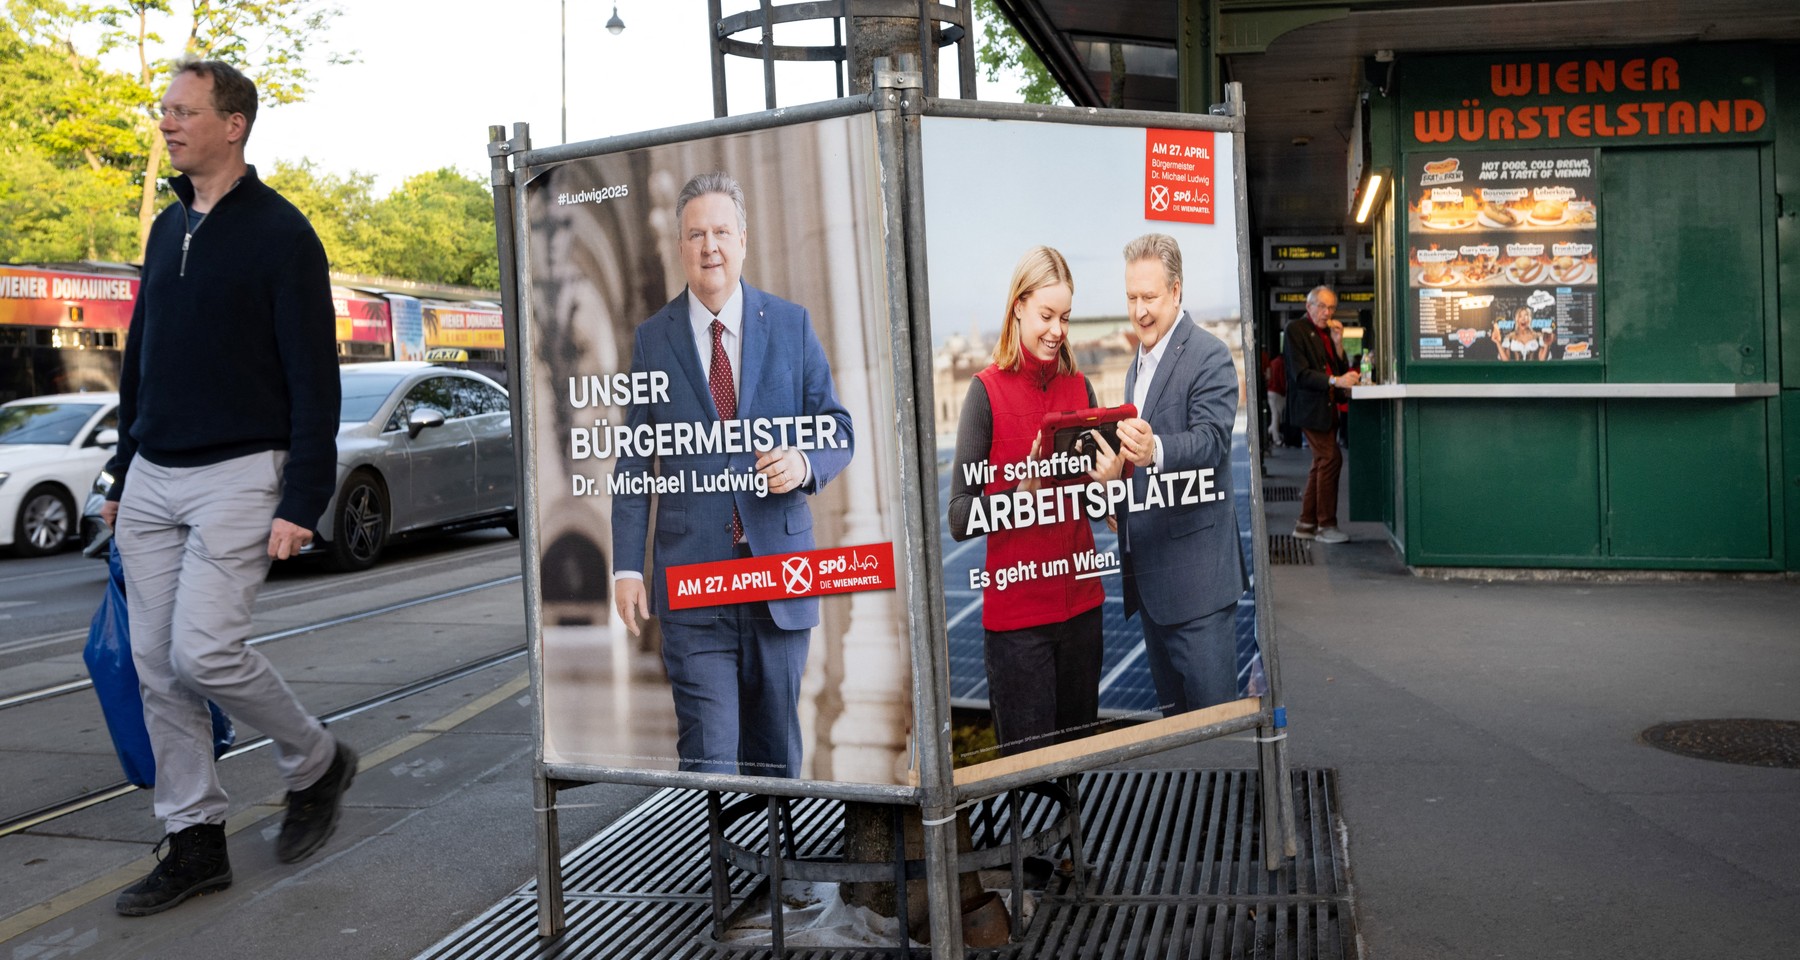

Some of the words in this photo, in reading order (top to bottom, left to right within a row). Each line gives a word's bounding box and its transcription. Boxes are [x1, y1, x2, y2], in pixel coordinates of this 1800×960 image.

[1490, 57, 1680, 96] WIENER
[1414, 99, 1766, 143] WÜRSTELSTAND
[1152, 142, 1166, 154] AM
[1170, 144, 1182, 156] 27.
[1184, 146, 1209, 159] APRIL
[1152, 159, 1195, 171] Bürgermeister
[1479, 171, 1498, 180] AND
[1500, 171, 1508, 179] A
[1510, 170, 1539, 179] TASTE
[1540, 170, 1552, 178] OF
[1555, 168, 1591, 178] VIENNA!
[1482, 162, 1500, 170] HOT
[1530, 160, 1554, 169] COLD
[1152, 171, 1160, 179] Dr.
[1162, 171, 1186, 182] Michael
[1188, 175, 1209, 186] Ludwig
[558, 185, 628, 205] #Ludwig2025
[1173, 190, 1191, 202] SPÖ
[52, 278, 133, 299] DONAUINSEL
[569, 370, 670, 408] UNSER
[571, 415, 848, 460] BÜRGERMEISTER.
[962, 462, 997, 486] Wir
[1004, 452, 1092, 482] schaffen
[572, 474, 599, 496] Dr.
[607, 470, 685, 495] Michael
[692, 467, 768, 498] Ludwig
[965, 468, 1226, 535] ARBEITSPLÄTZE.
[818, 556, 846, 574] SPÖ
[969, 568, 990, 590] Es
[995, 560, 1037, 591] geht
[1042, 558, 1069, 577] um
[1073, 550, 1120, 575] Wien.
[677, 578, 700, 596] AM
[705, 576, 727, 593] 27.
[732, 570, 776, 590] APRIL
[820, 580, 831, 589] DIE
[833, 575, 882, 588] WIENPARTEI.
